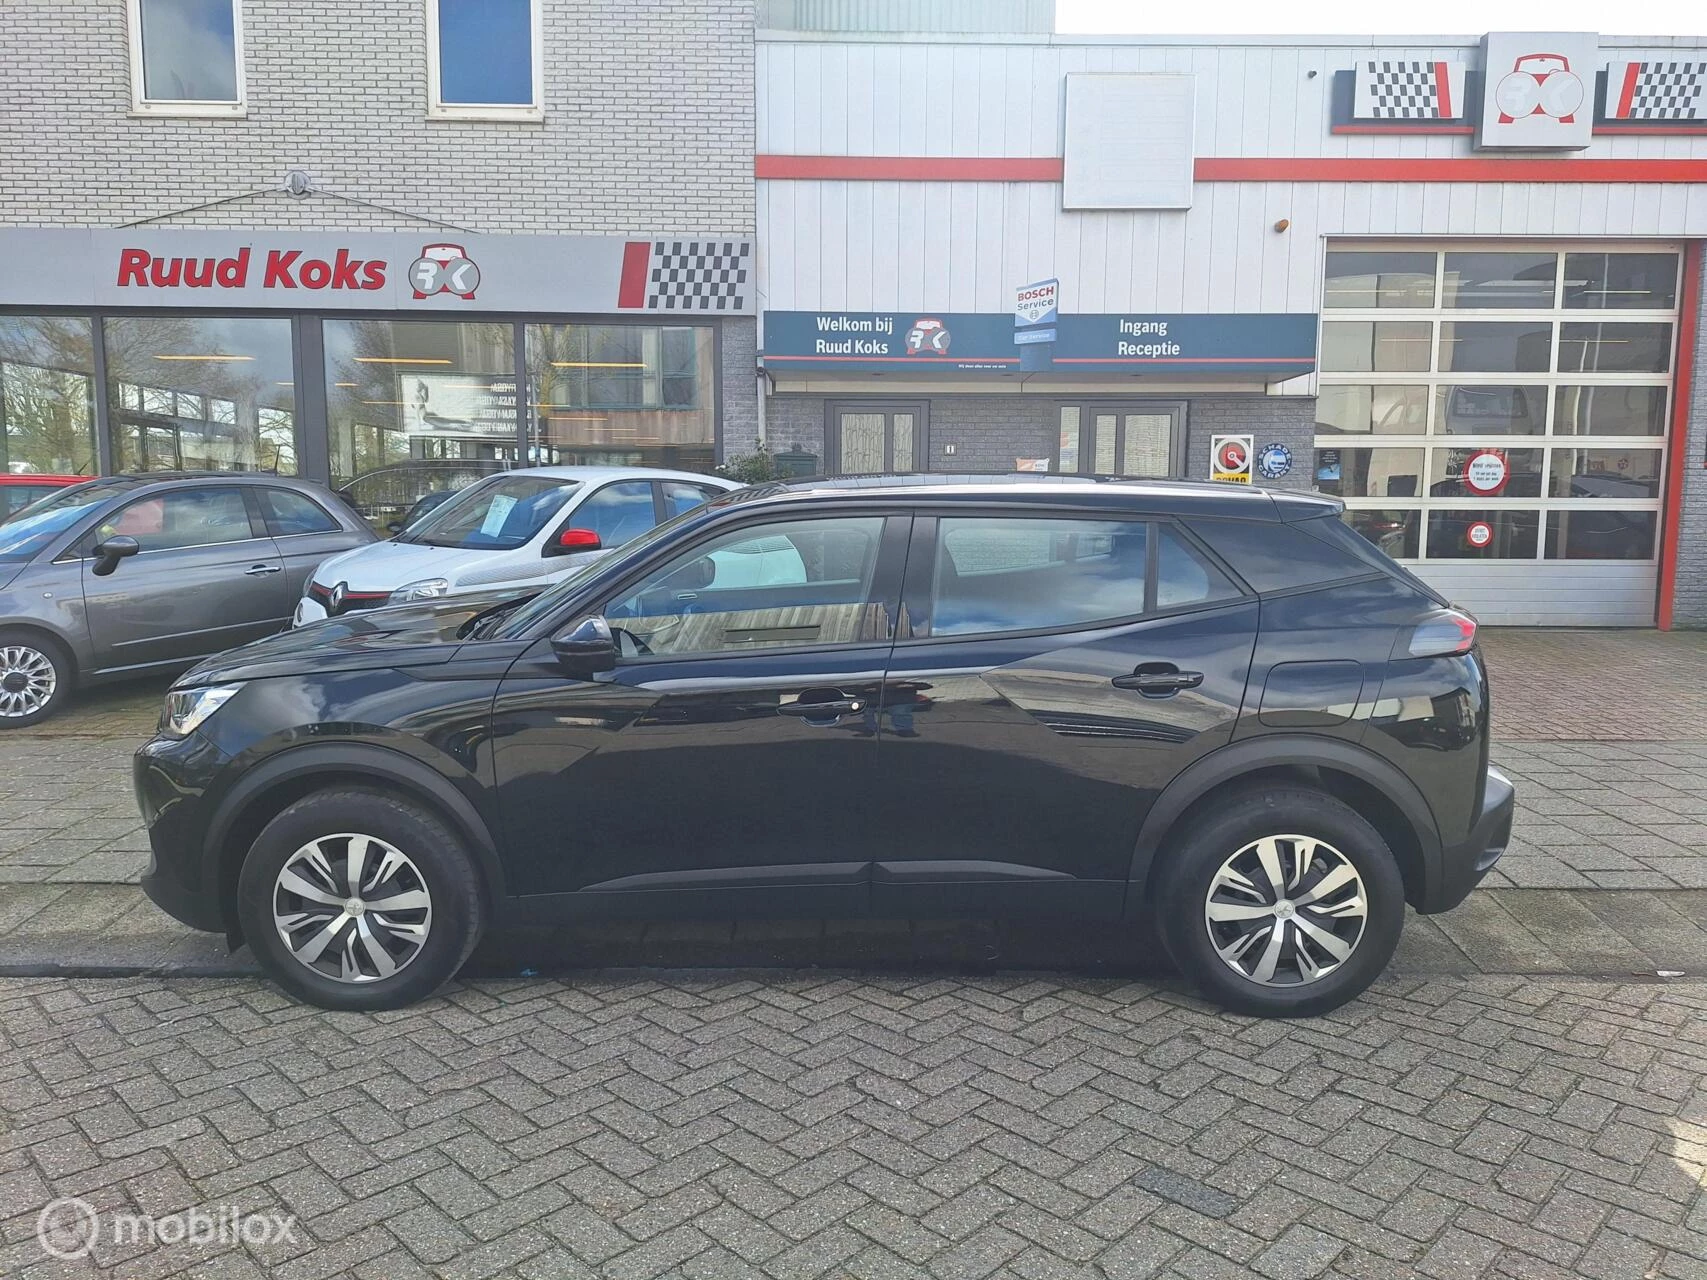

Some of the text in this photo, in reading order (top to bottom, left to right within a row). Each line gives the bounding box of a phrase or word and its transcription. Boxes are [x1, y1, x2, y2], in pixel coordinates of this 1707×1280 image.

[117, 247, 387, 290] Ruud Koks
[1018, 286, 1054, 302] BOSCH
[1017, 298, 1054, 311] Service
[816, 317, 893, 334] Welkom bij
[1120, 319, 1168, 336] Ingang
[816, 339, 889, 354] Ruud Koks
[1118, 341, 1180, 358] Receptie
[1258, 444, 1291, 460] SCHADE
[1258, 462, 1290, 478] GARANT
